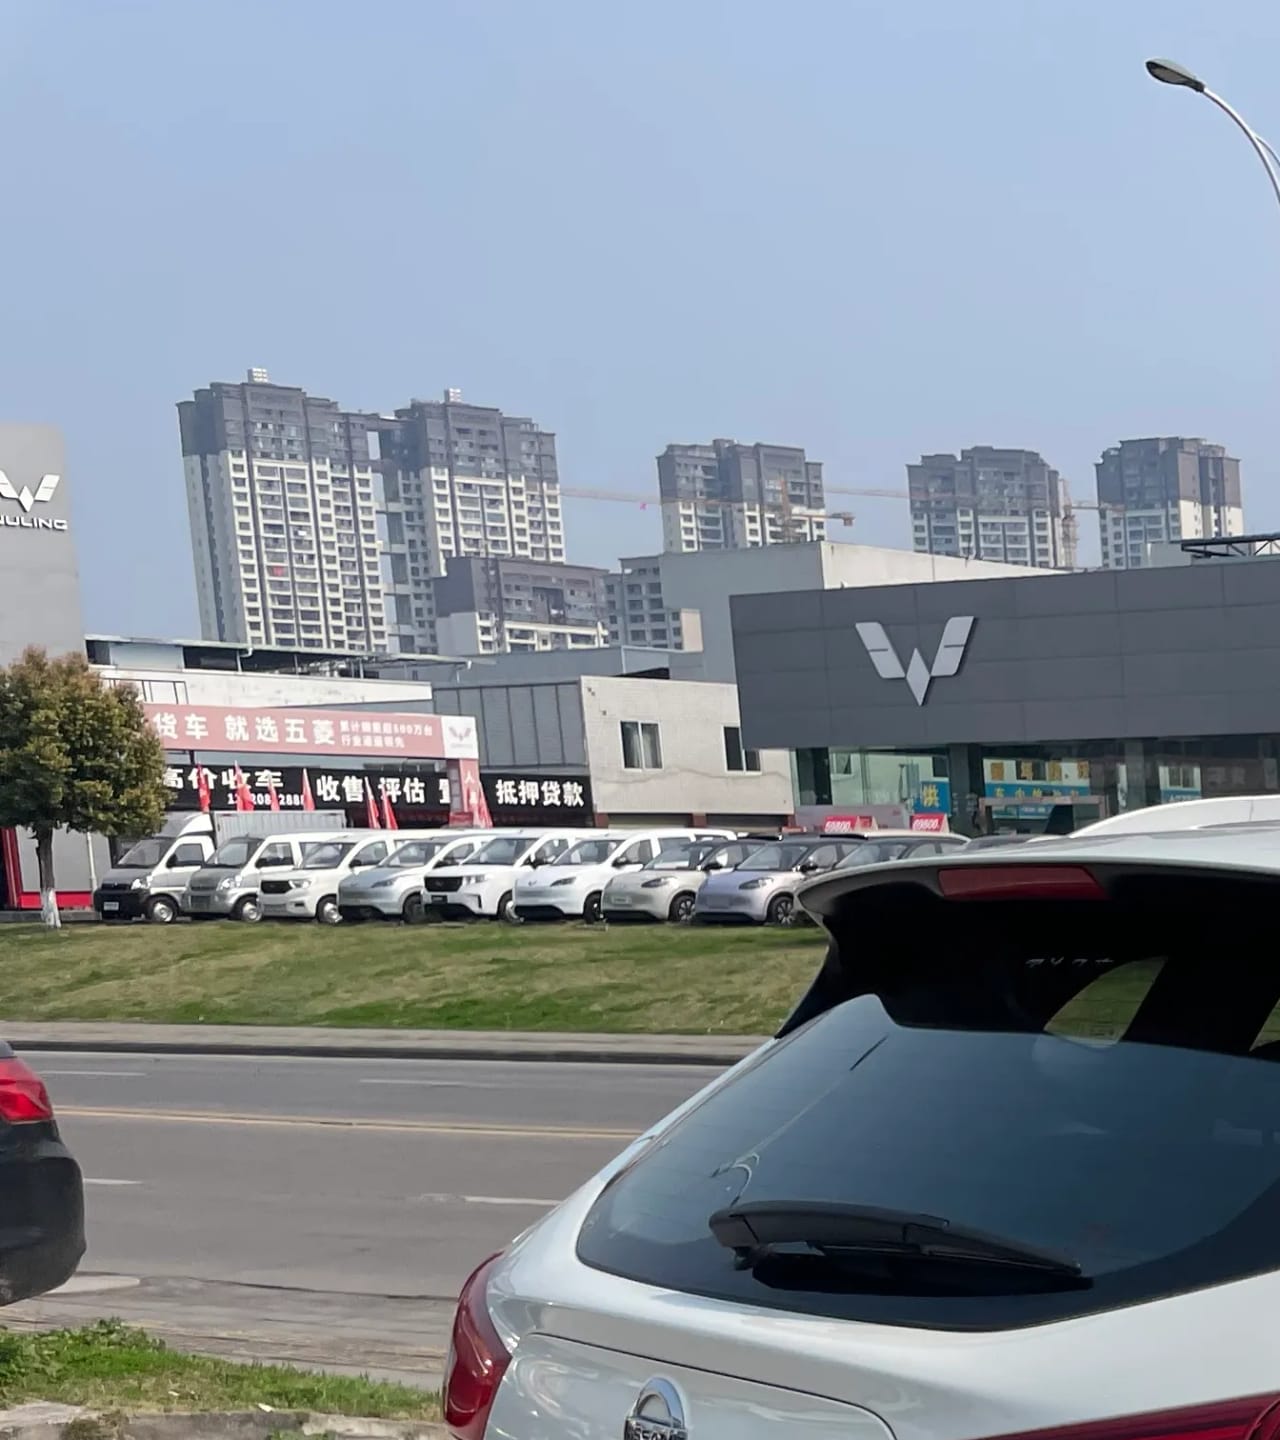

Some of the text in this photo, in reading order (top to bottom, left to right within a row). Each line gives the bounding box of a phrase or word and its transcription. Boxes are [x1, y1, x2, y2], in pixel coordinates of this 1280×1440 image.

[0, 515, 68, 531] ULING
[224, 714, 335, 745] 就选五菱
[378, 777, 425, 804] 评估
[495, 779, 585, 808] 抵押贷款
